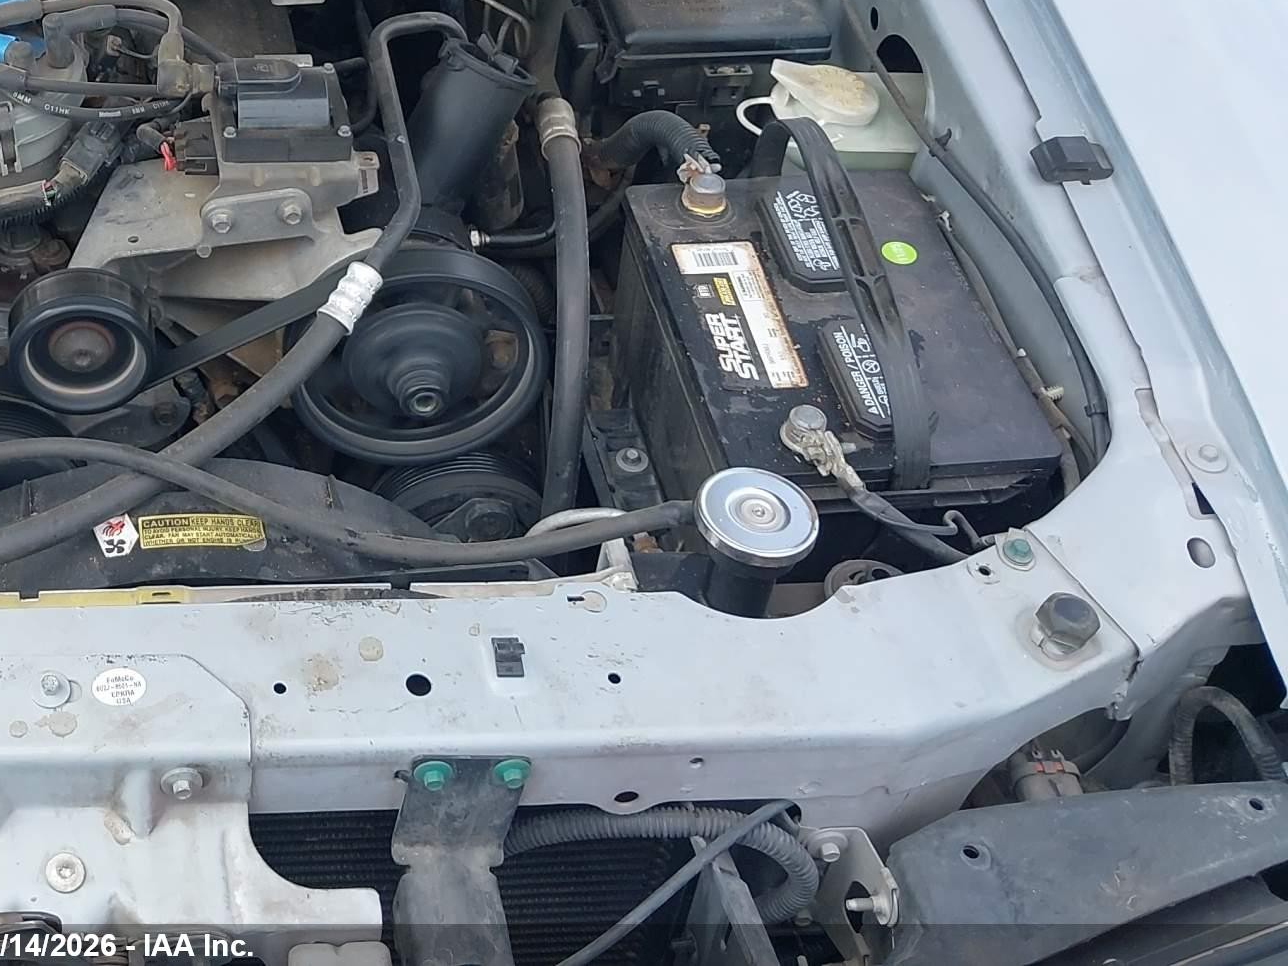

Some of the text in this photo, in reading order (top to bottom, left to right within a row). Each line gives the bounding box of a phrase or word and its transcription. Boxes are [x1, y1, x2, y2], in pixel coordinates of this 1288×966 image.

[44, 103, 71, 116] C11HK
[705, 312, 735, 372] SUPER
[718, 312, 760, 381] START
[833, 331, 856, 364] POISON
[850, 370, 876, 406] DANGER
[143, 518, 189, 528] CAUTION
[190, 517, 209, 526] KEEP
[211, 517, 235, 526] HANDS
